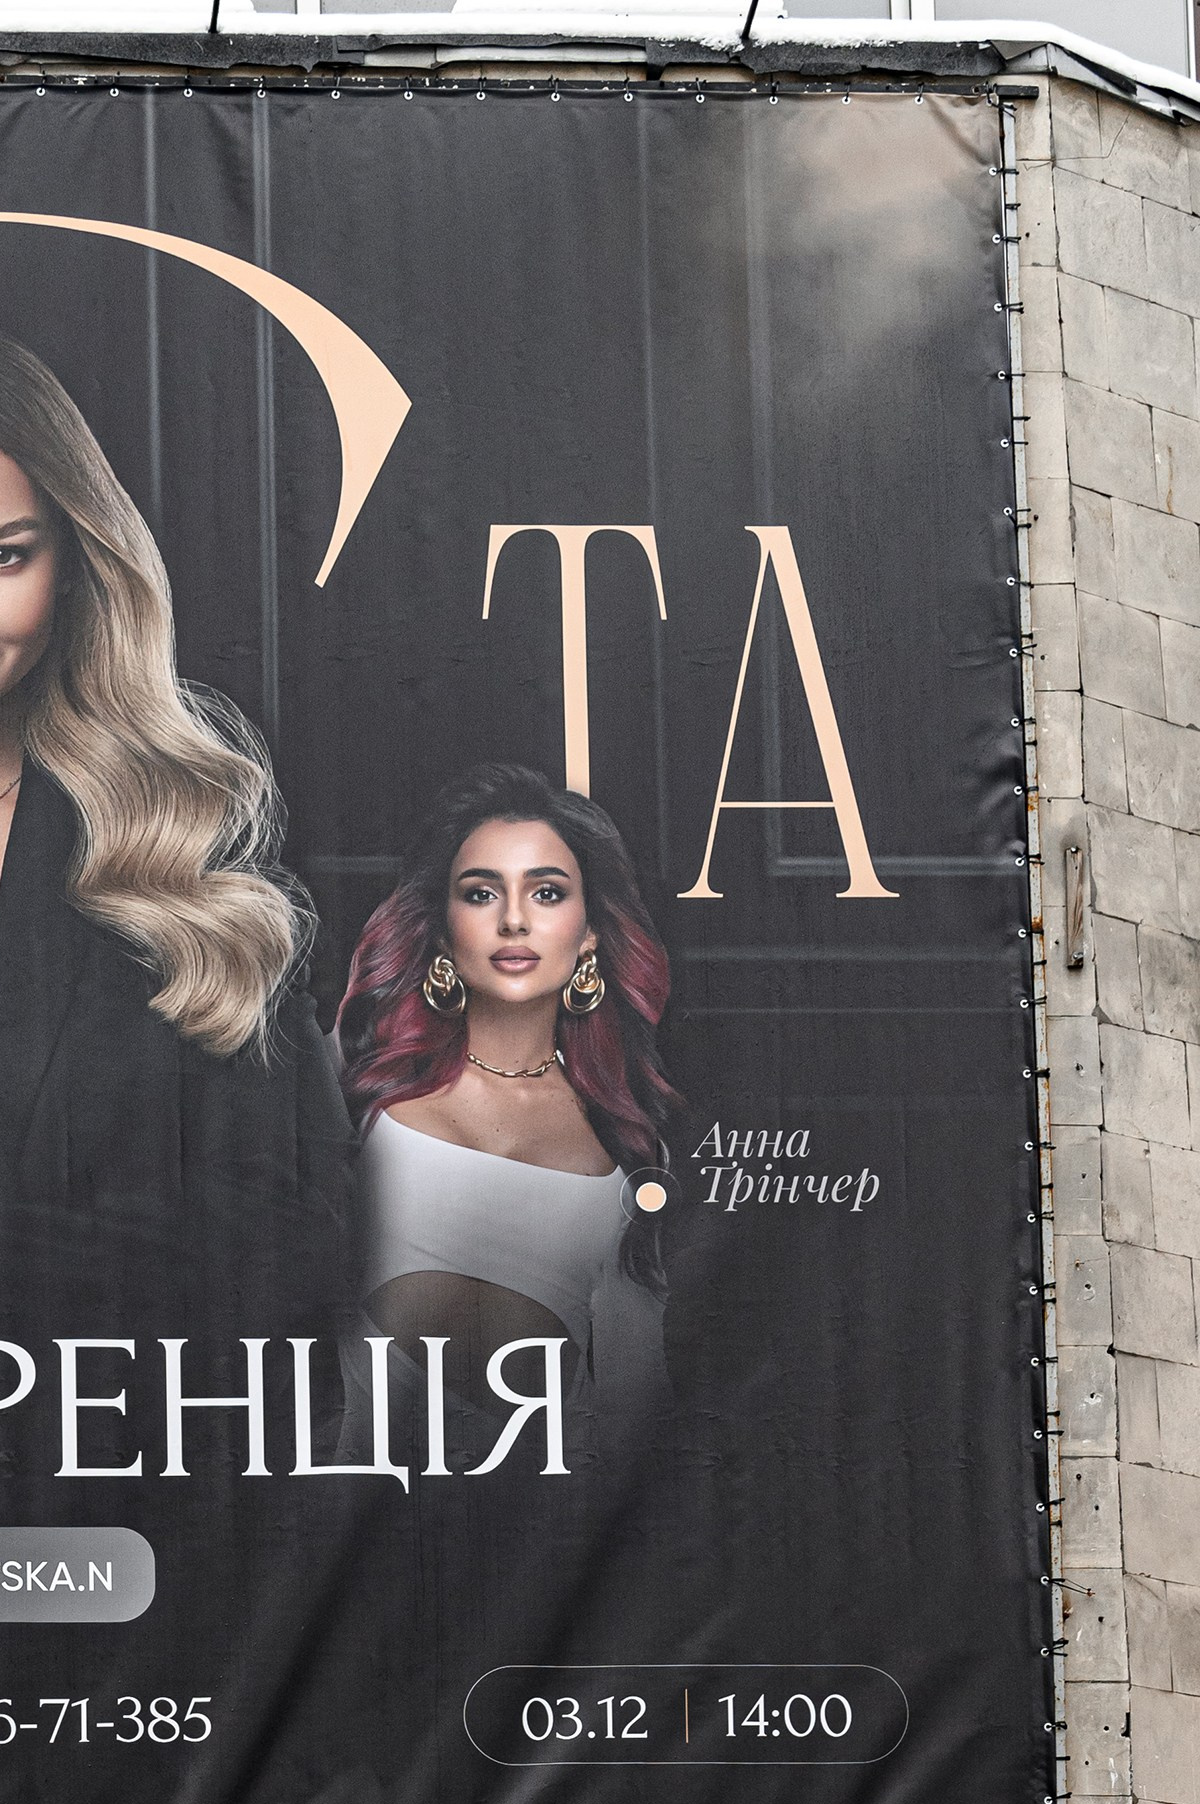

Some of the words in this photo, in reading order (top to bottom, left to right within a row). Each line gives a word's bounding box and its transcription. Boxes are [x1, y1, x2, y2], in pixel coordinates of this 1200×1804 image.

[690, 1121, 811, 1159] Анна
[700, 1160, 880, 1212] Трінчер
[521, 1695, 649, 1741] 03.12
[718, 1693, 853, 1738] 14:00
